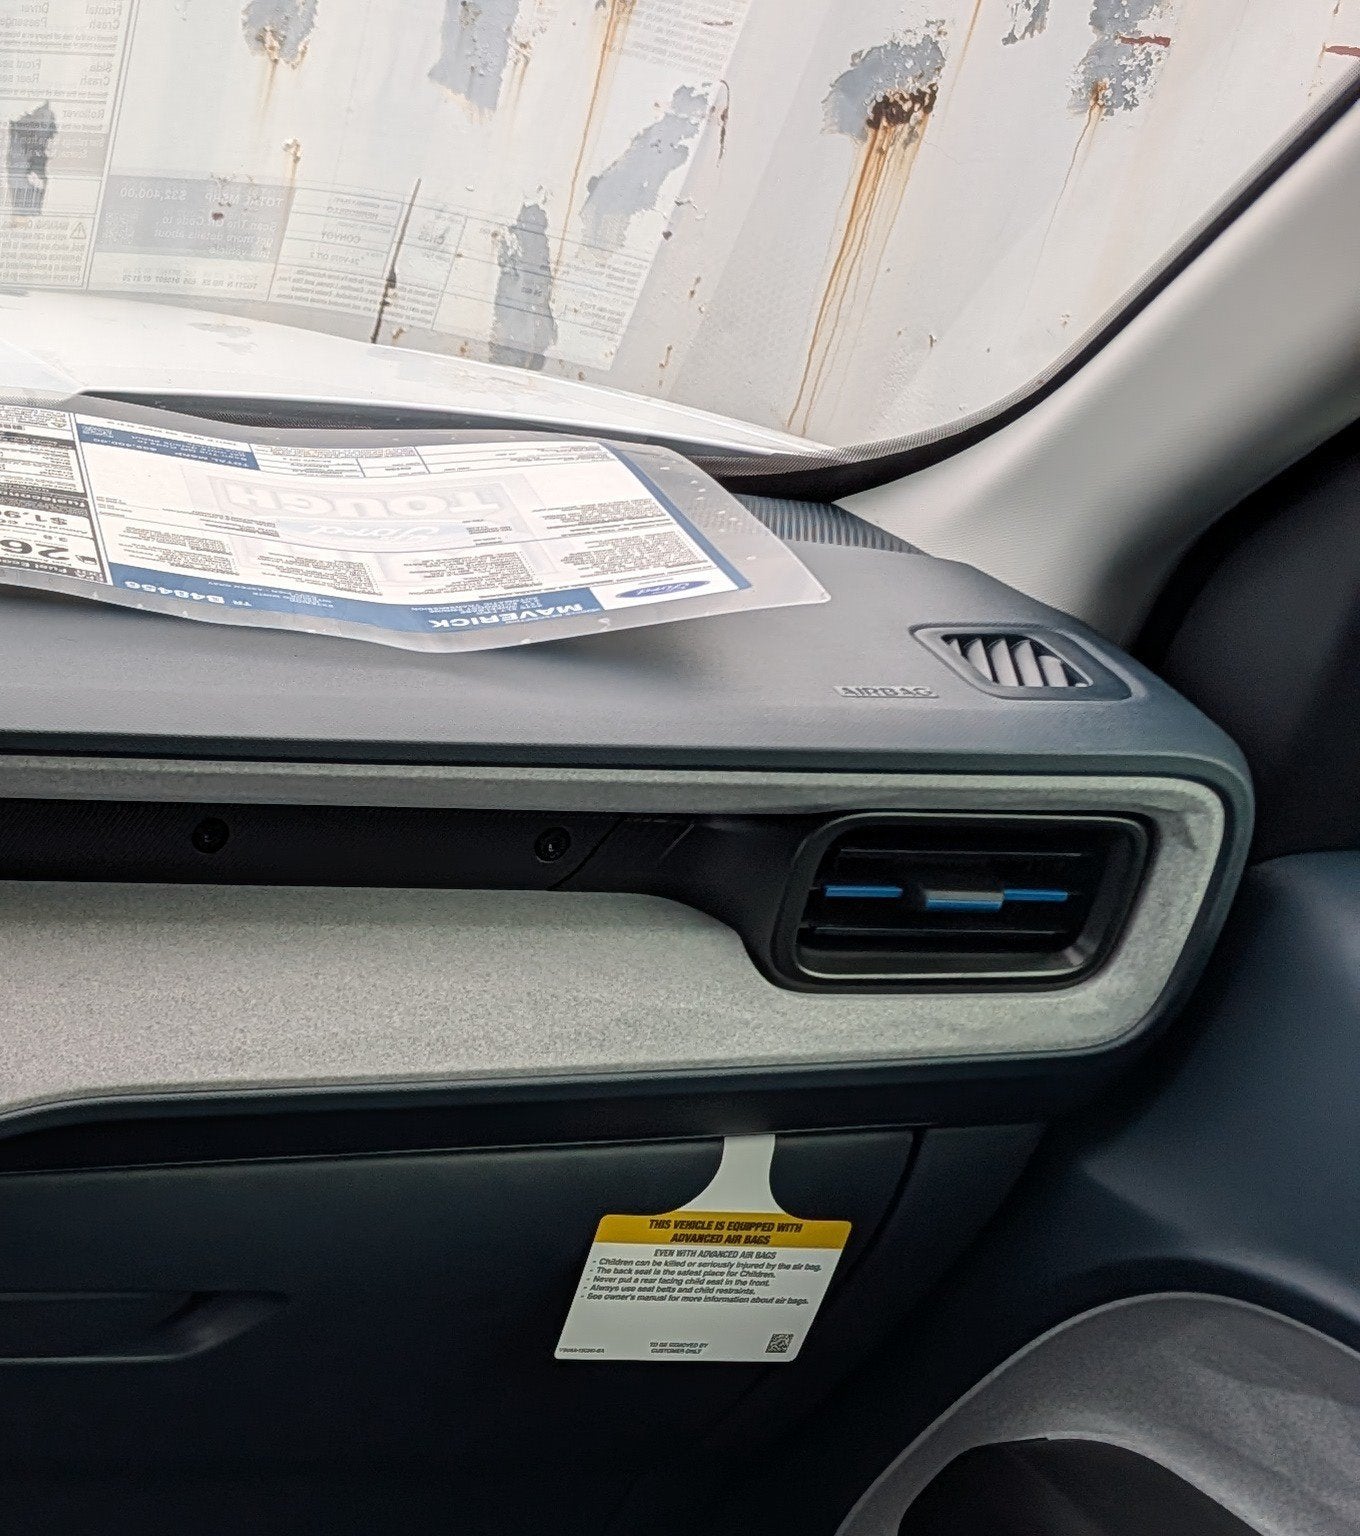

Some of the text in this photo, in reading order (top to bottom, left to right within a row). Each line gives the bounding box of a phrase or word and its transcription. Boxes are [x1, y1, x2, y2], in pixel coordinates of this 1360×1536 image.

[0, 539, 70, 561] 26
[427, 603, 584, 628] MAVERICK
[841, 687, 934, 697] AIRBAG
[649, 1219, 803, 1233] THIS VEHICLE IS EQUIPPED WITH
[669, 1233, 771, 1245] ADVANCED AIR BAGS
[653, 1249, 777, 1260] EVEN WITH ADVANCED AIR BAGS
[599, 1258, 634, 1266] Children
[664, 1260, 685, 1268] killed
[697, 1261, 735, 1271] seriously
[736, 1261, 764, 1270] injured
[765, 1262, 777, 1271] by
[804, 1264, 821, 1272] bag.
[596, 1266, 612, 1274] The
[613, 1267, 633, 1275] back
[677, 1268, 701, 1276] safest
[702, 1270, 724, 1278] place
[739, 1270, 776, 1279] Children.
[658, 1277, 683, 1286] facing
[748, 1279, 770, 1287] front.
[589, 1285, 619, 1293] Always
[656, 1285, 675, 1293] belts
[787, 1298, 809, 1306] bags.
